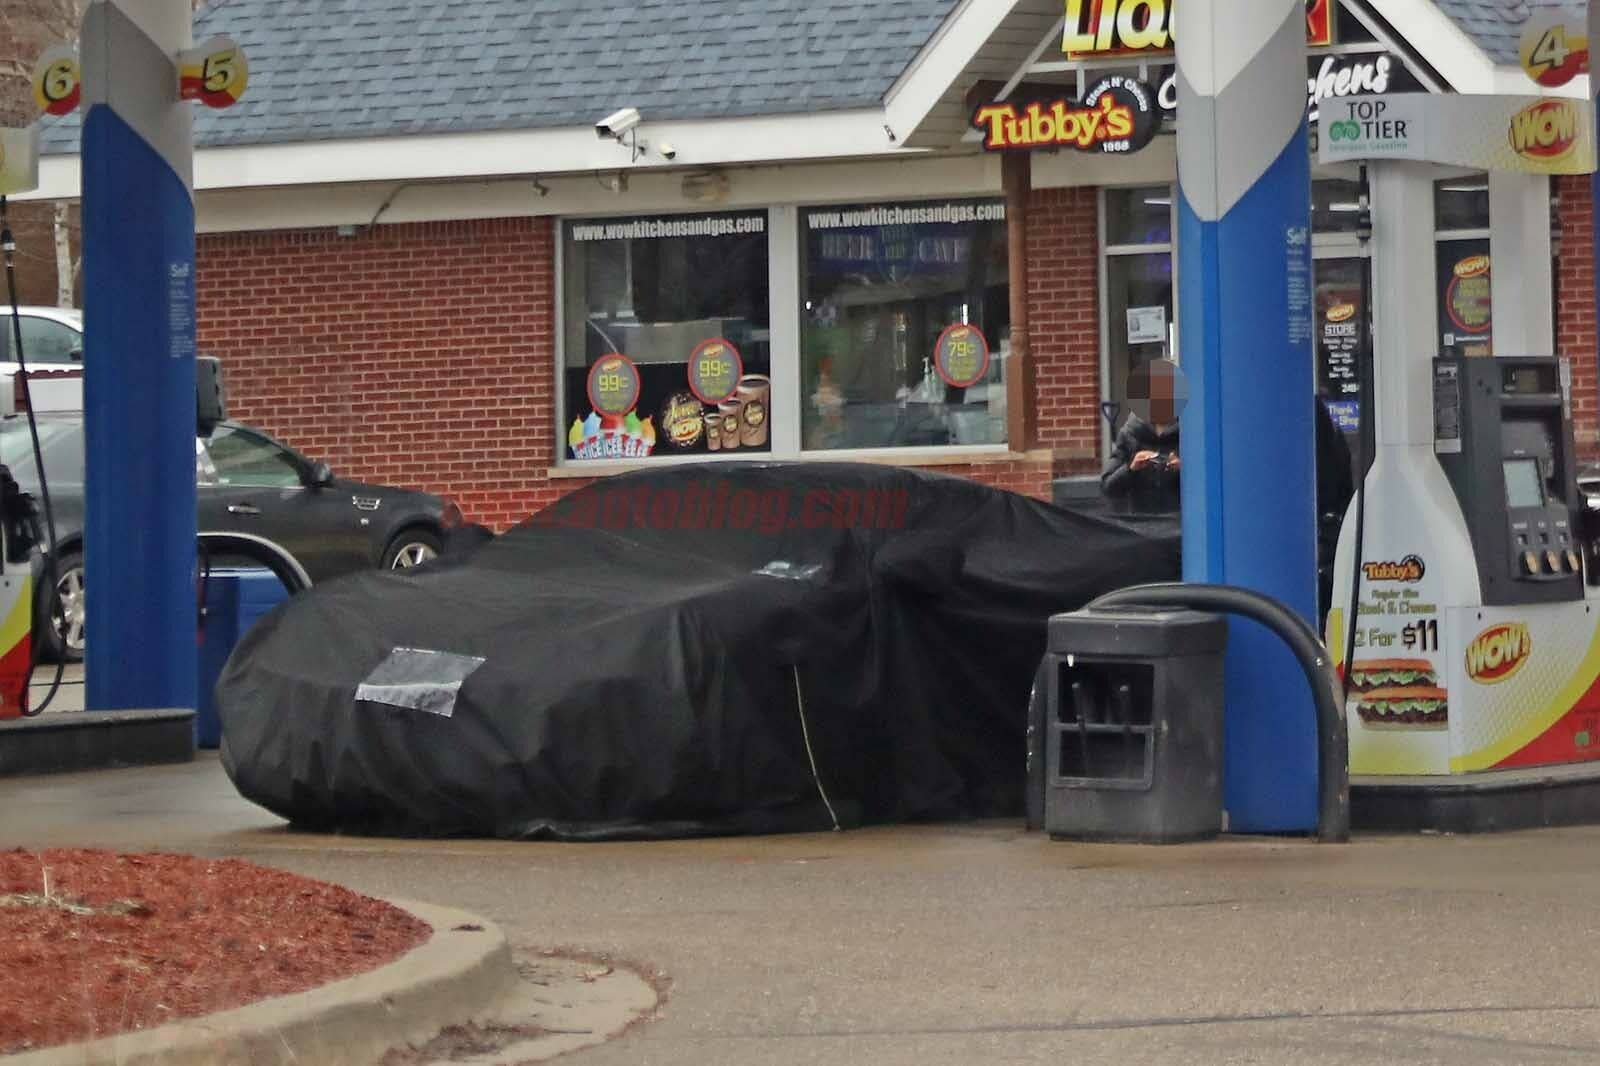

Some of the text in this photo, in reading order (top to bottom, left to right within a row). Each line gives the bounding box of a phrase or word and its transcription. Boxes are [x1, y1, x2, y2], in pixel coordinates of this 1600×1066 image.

[1528, 24, 1570, 69] 4
[43, 58, 74, 102] 6
[202, 49, 235, 94] 5
[977, 95, 1133, 150] Tubby's
[1346, 101, 1386, 121] TOP
[1360, 120, 1408, 140] TIER
[573, 216, 764, 241] www.wowkitchensandgas.com
[808, 203, 1006, 229] www.wowkitchensandgas.com
[1363, 559, 1419, 582] Tubby's
[1369, 627, 1397, 647] For
[1401, 619, 1439, 653] $11
[1465, 622, 1533, 677] WOW!
